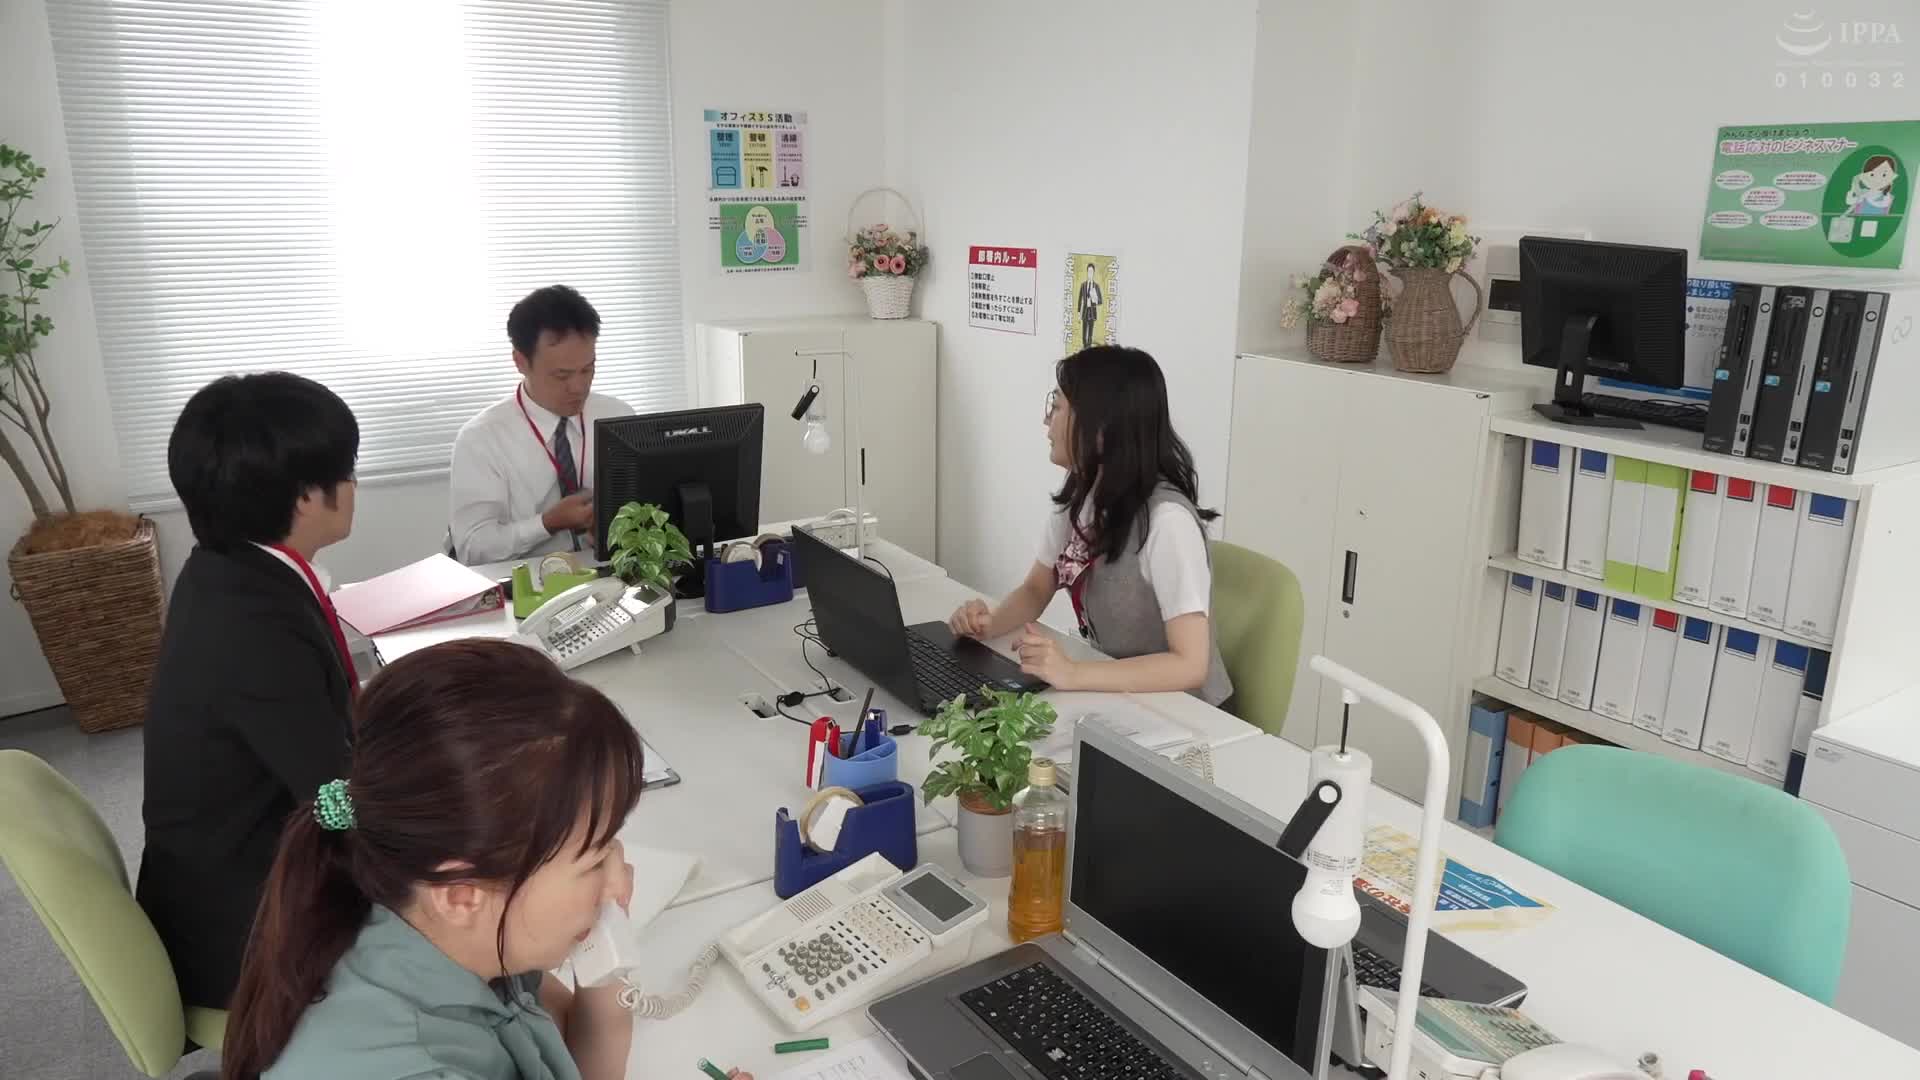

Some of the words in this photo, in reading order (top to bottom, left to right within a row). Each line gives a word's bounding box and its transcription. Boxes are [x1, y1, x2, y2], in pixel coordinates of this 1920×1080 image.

[1720, 138, 1858, 155] 電話応対のビジネスマナー
[978, 250, 1027, 264] 部署内ルール
